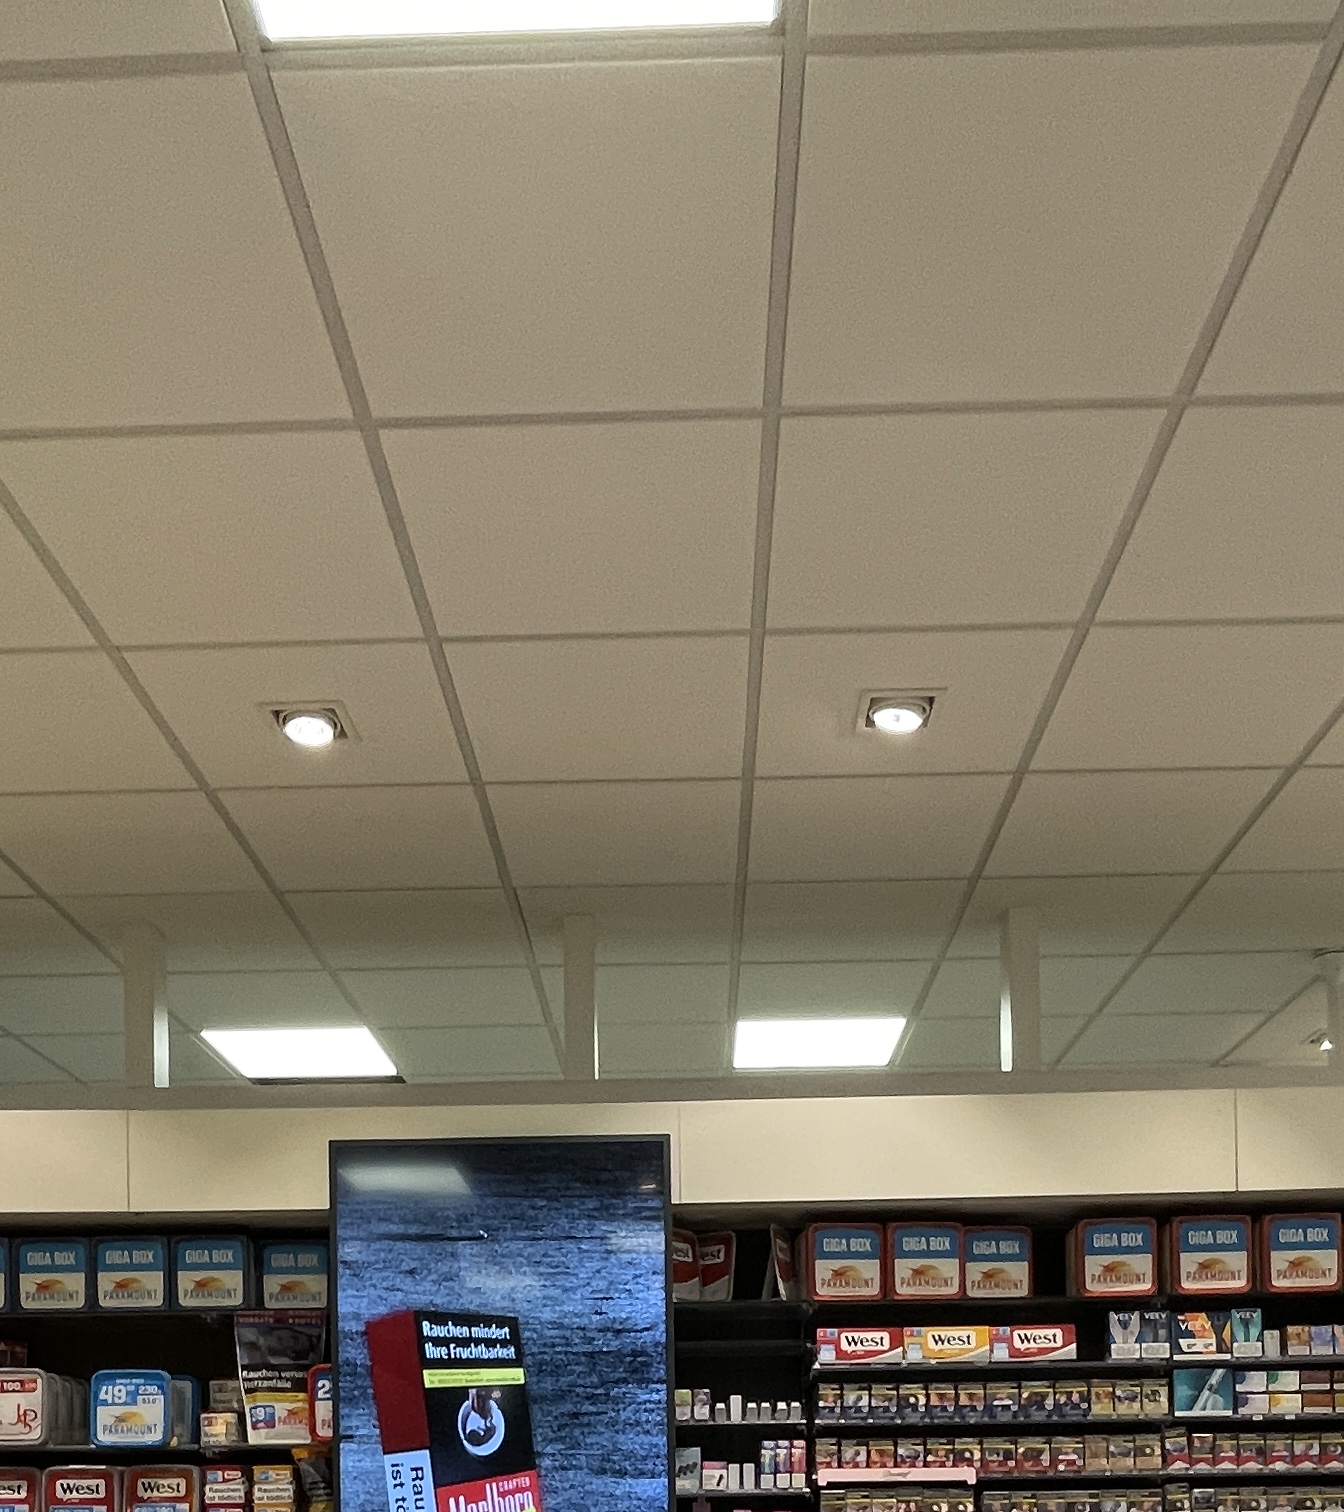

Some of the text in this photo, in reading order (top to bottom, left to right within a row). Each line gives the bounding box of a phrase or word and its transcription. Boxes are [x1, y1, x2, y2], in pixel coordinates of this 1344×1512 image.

[1093, 1233, 1143, 1247] GIGA BOX
[1189, 1230, 1238, 1245] GIGA BOX
[1279, 1228, 1329, 1243] GIGA BOX
[824, 1238, 871, 1251] GIGA BOX
[902, 1237, 950, 1251] GIGA BOX
[973, 1240, 1020, 1254] GIGA BOX
[1090, 1273, 1146, 1285] PARAMOUNT
[1186, 1270, 1241, 1283] PARAMOUNT
[1277, 1267, 1332, 1280] PARAMOUNT
[821, 1278, 874, 1290] PARAMOUNT
[900, 1276, 953, 1289] PARAMOUNT
[971, 1279, 1023, 1291] PARAMOUNT
[422, 1321, 511, 1340] Rauchen mindert
[845, 1334, 884, 1348] West
[932, 1333, 971, 1346] West
[1017, 1331, 1056, 1345] West
[425, 1344, 516, 1359] Ihre Fruchtbarkeit
[100, 1385, 126, 1404] 49
[103, 1424, 158, 1436] PARAMOUNT
[390, 1463, 404, 1490] ist
[60, 1481, 101, 1495] West
[142, 1481, 181, 1494] West
